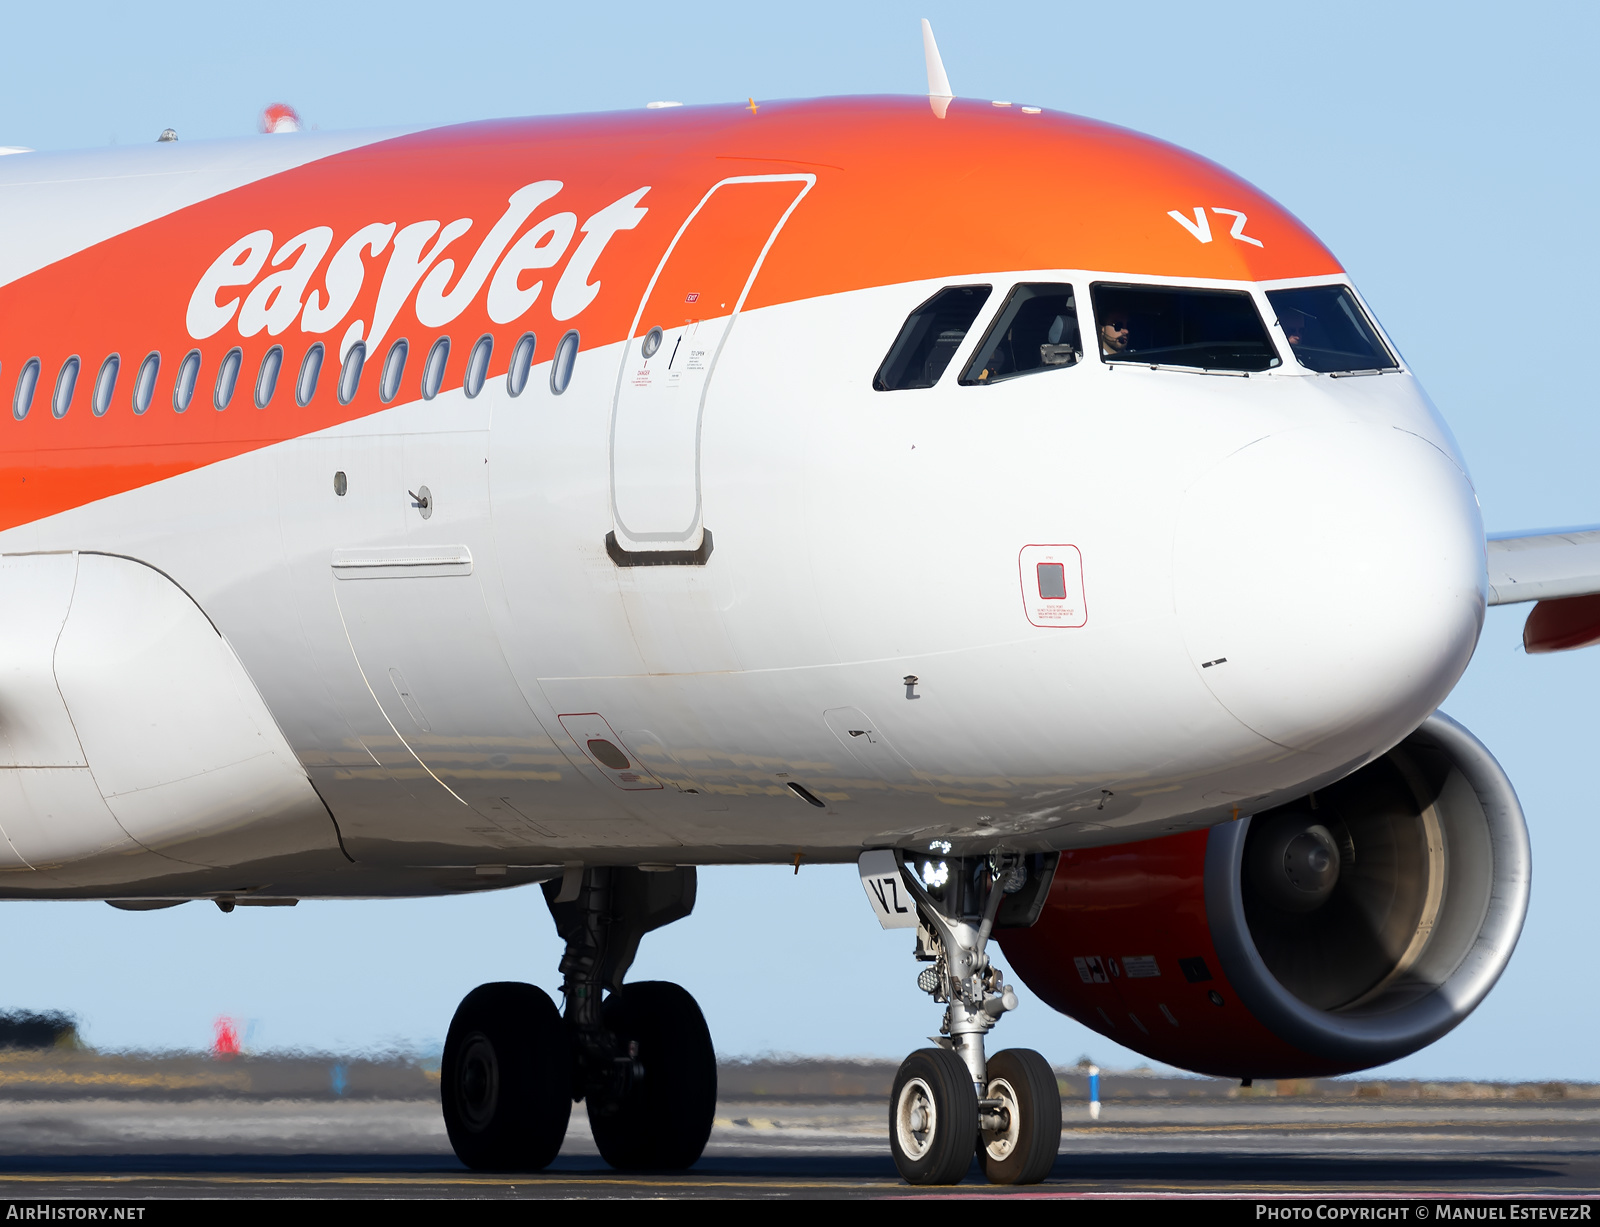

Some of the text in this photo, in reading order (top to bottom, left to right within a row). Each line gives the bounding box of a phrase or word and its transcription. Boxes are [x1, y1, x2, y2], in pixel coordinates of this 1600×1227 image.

[1167, 206, 1264, 248] VZ
[186, 180, 652, 366] easyJet
[868, 878, 908, 914] VZ
